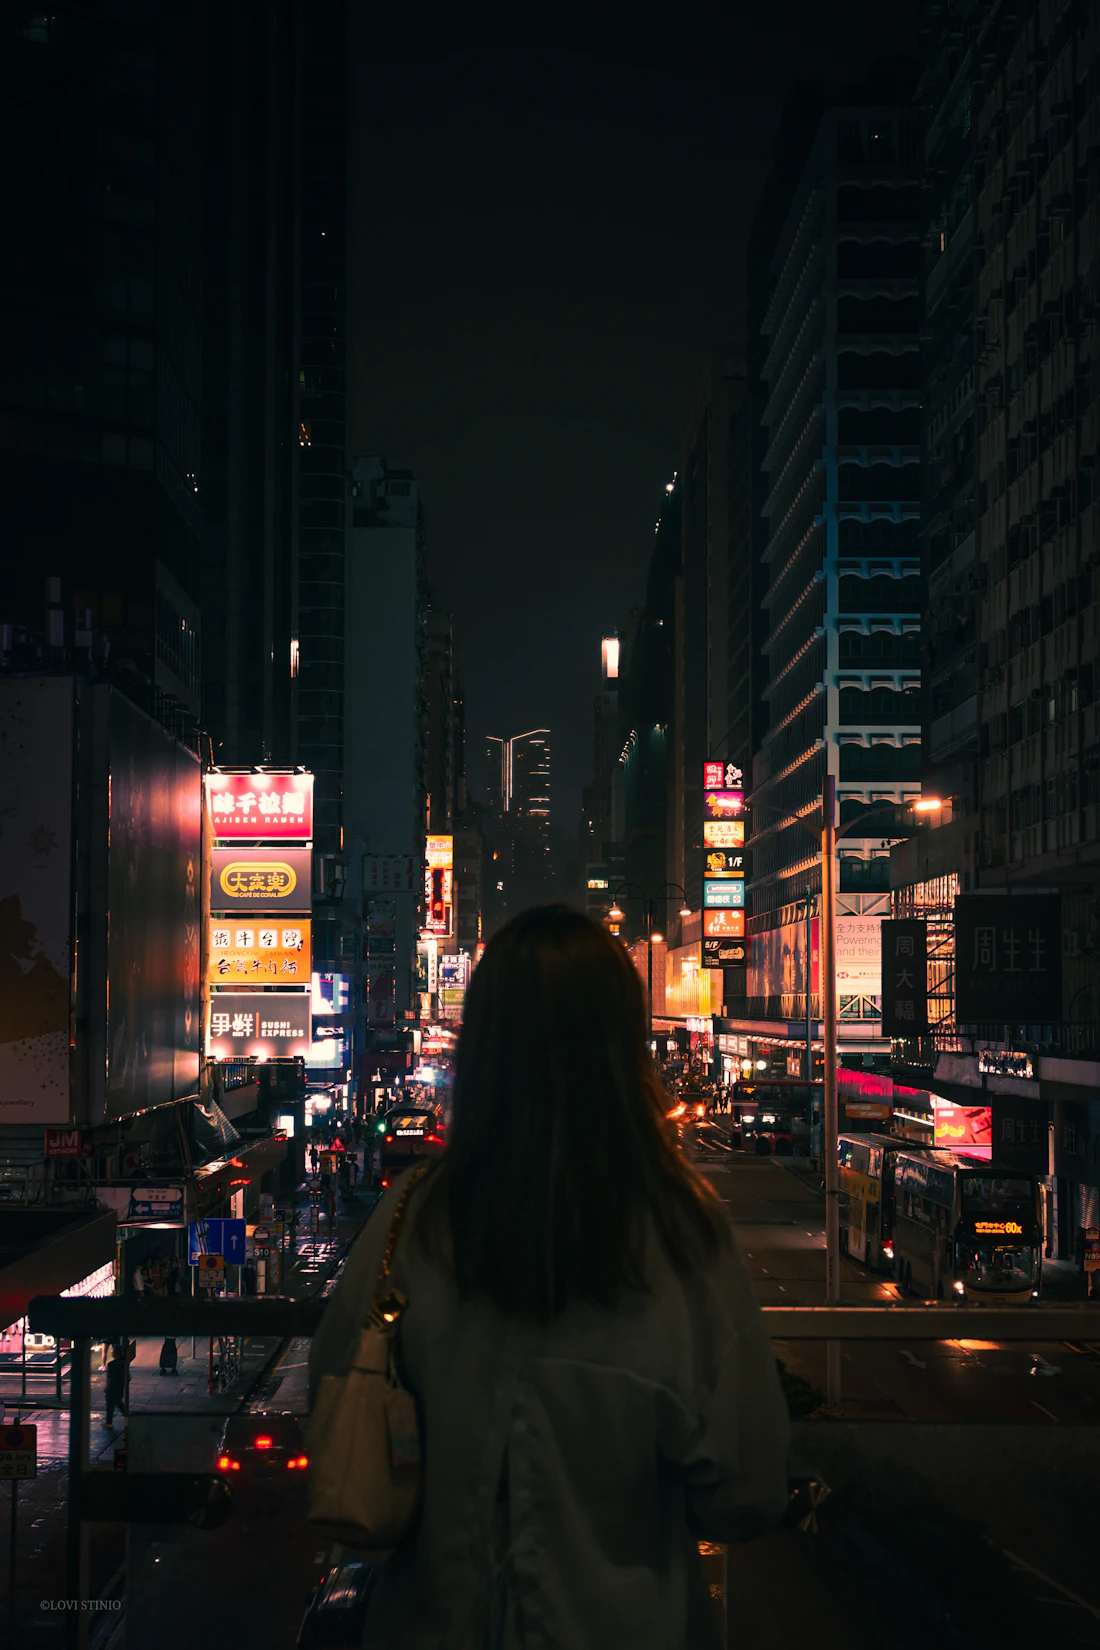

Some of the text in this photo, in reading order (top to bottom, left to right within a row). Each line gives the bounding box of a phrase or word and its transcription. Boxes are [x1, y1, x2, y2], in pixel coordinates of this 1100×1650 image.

[725, 808, 741, 817] 3/F
[728, 856, 743, 867] 1/F
[705, 941, 719, 949] 5/F
[971, 925, 1048, 972] 周生生
[836, 946, 880, 956] and their
[895, 935, 915, 1021] 周大福
[261, 1021, 291, 1029] SUSHI
[261, 1029, 304, 1037] EXPRESS
[49, 1130, 79, 1148] JM
[254, 1248, 269, 1256] S10
[16, 1452, 32, 1461] hrs
[2, 1464, 27, 1476] 全日
